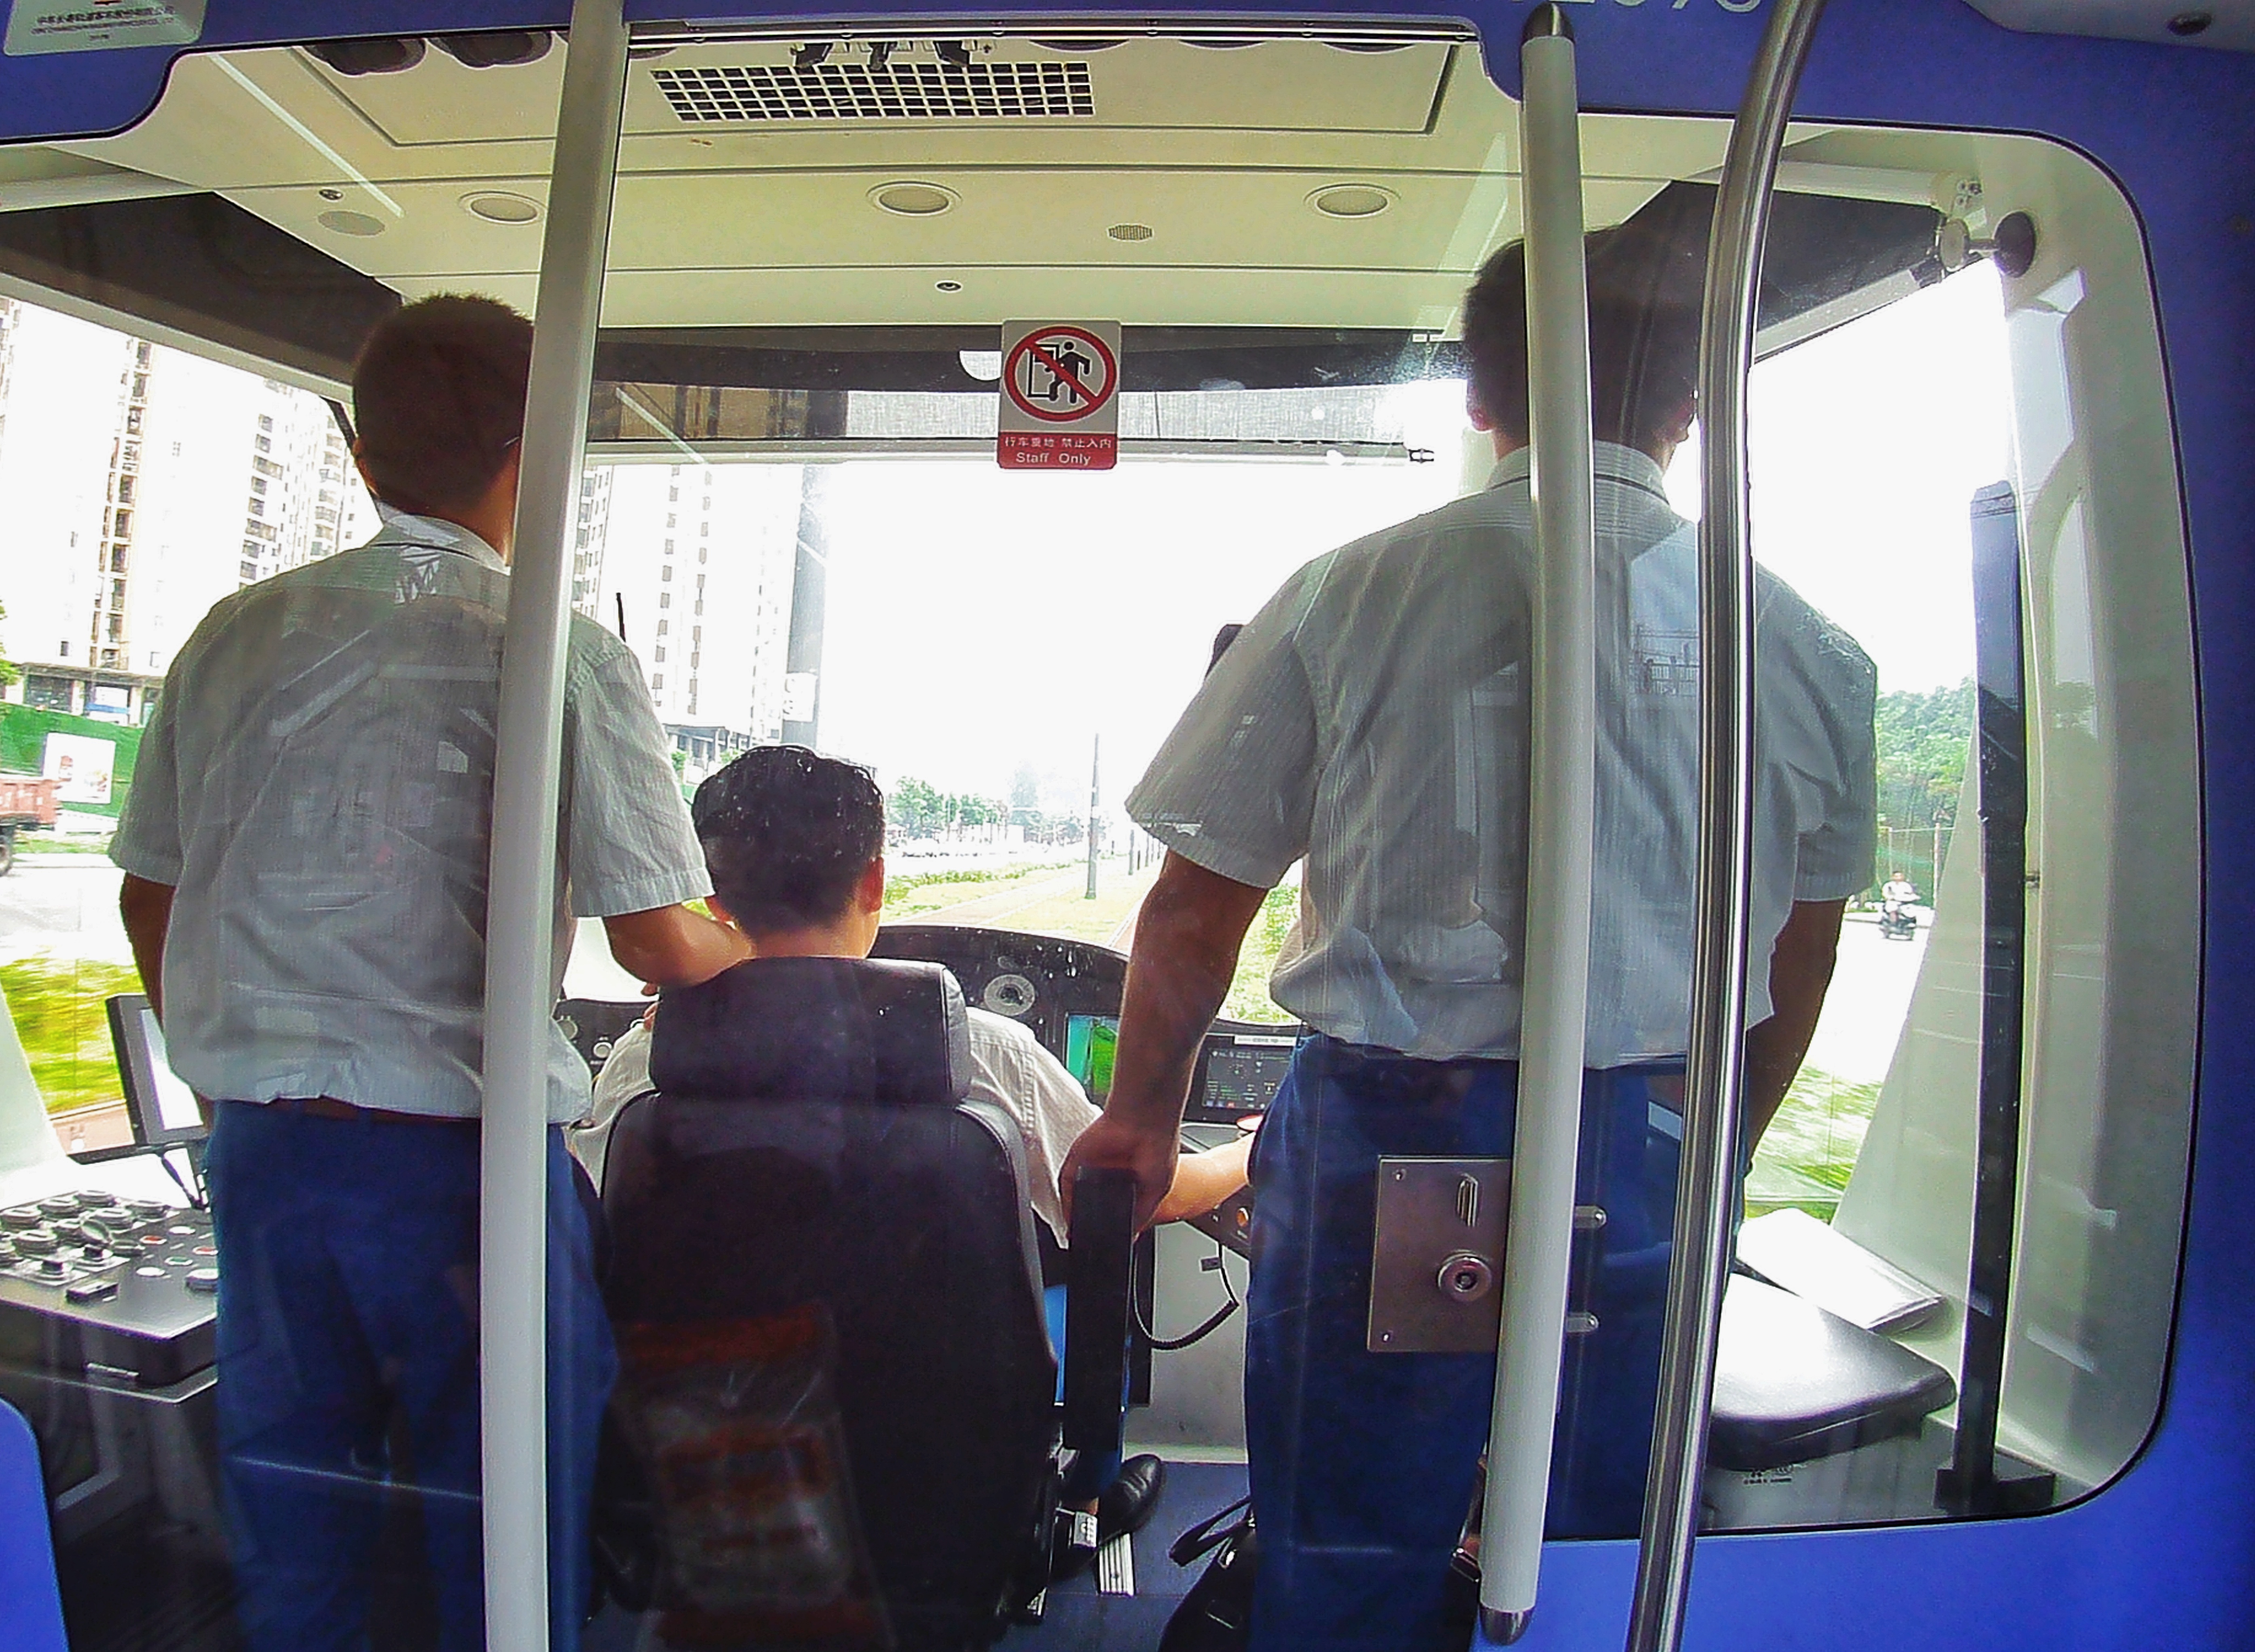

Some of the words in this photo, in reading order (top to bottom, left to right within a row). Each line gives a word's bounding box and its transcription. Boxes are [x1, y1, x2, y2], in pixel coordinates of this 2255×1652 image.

[1061, 438, 1111, 449] 禁止入内
[1016, 452, 1050, 463] Staff
[1059, 453, 1092, 466] Only
